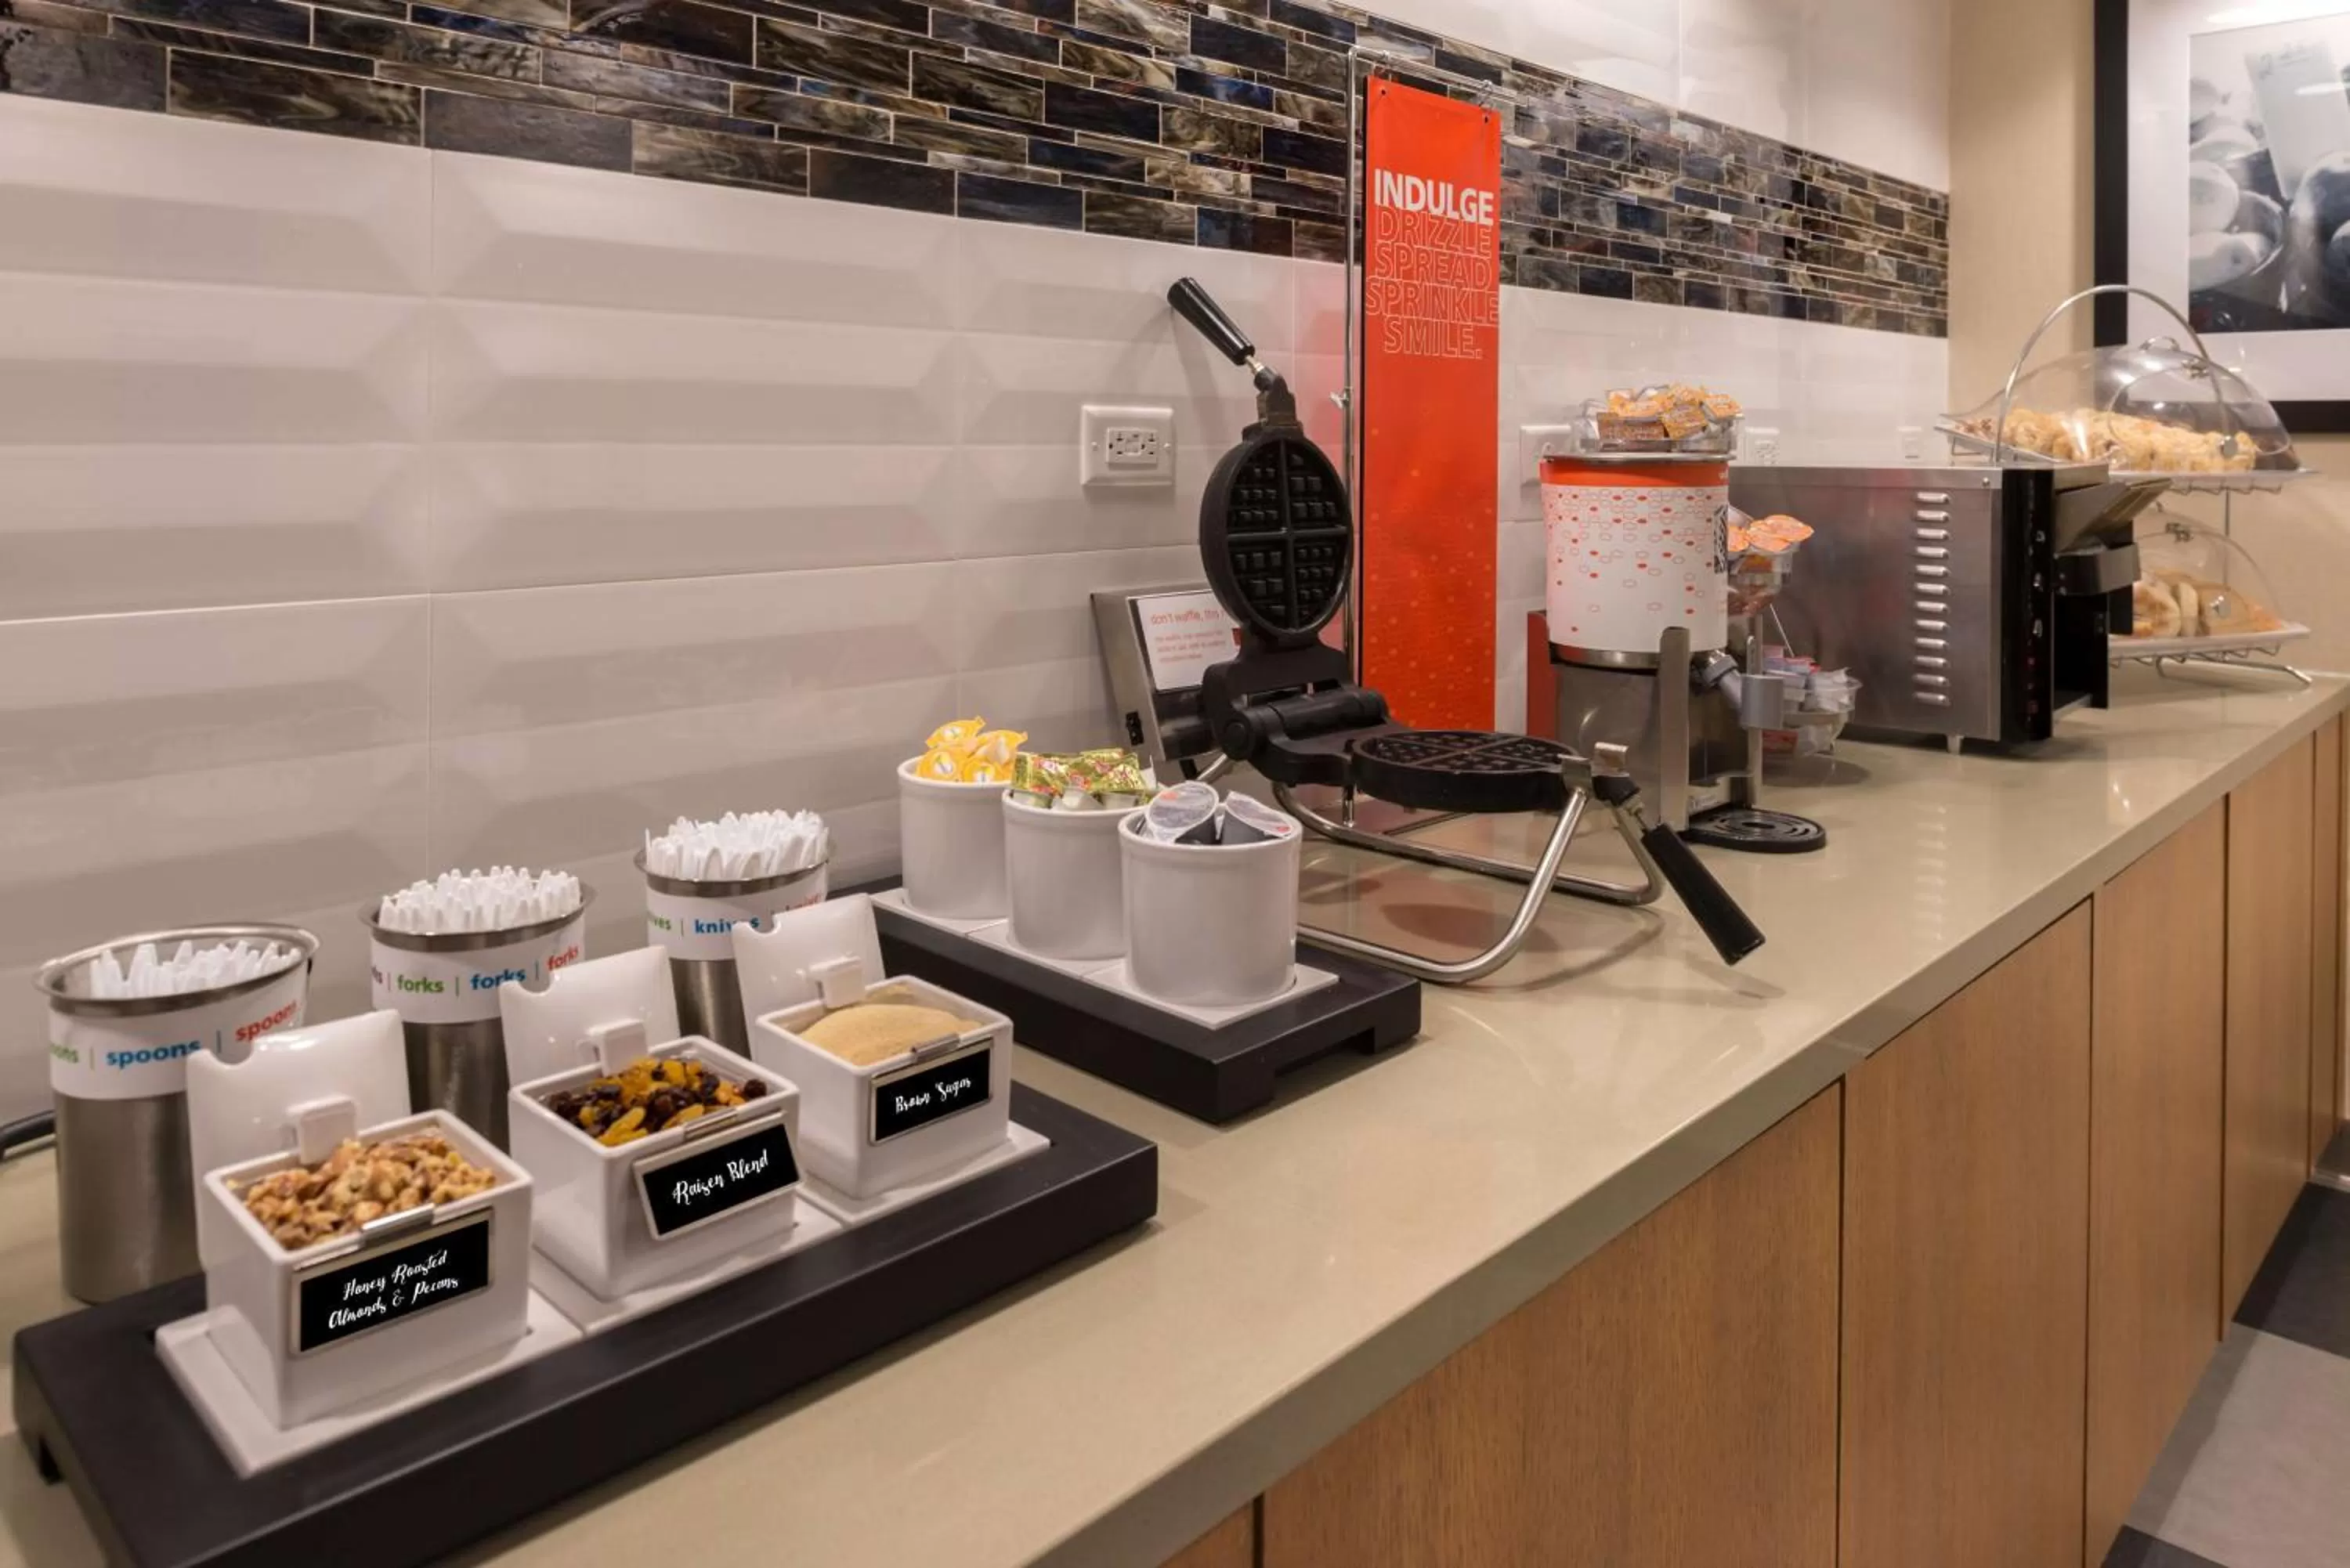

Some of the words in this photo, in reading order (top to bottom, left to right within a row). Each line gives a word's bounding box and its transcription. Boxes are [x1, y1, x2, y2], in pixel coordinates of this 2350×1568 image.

[1374, 168, 1494, 226] INDULGE
[1380, 207, 1492, 259] DRIZZLE
[1375, 240, 1492, 291] SPREAD
[1365, 276, 1499, 327] SPRINKLE
[1383, 315, 1483, 359] SMILE.
[397, 974, 445, 993] forks
[106, 1039, 201, 1069] spoons
[895, 1093, 931, 1115] Brown
[935, 1078, 971, 1102] Sugar
[672, 1179, 725, 1205] Raisen
[727, 1148, 769, 1181] Blend
[343, 1277, 386, 1301] Honey
[392, 1248, 447, 1284] Roasted
[328, 1296, 387, 1329] Almonds
[392, 1288, 405, 1307] &
[411, 1277, 459, 1305] Pecans
